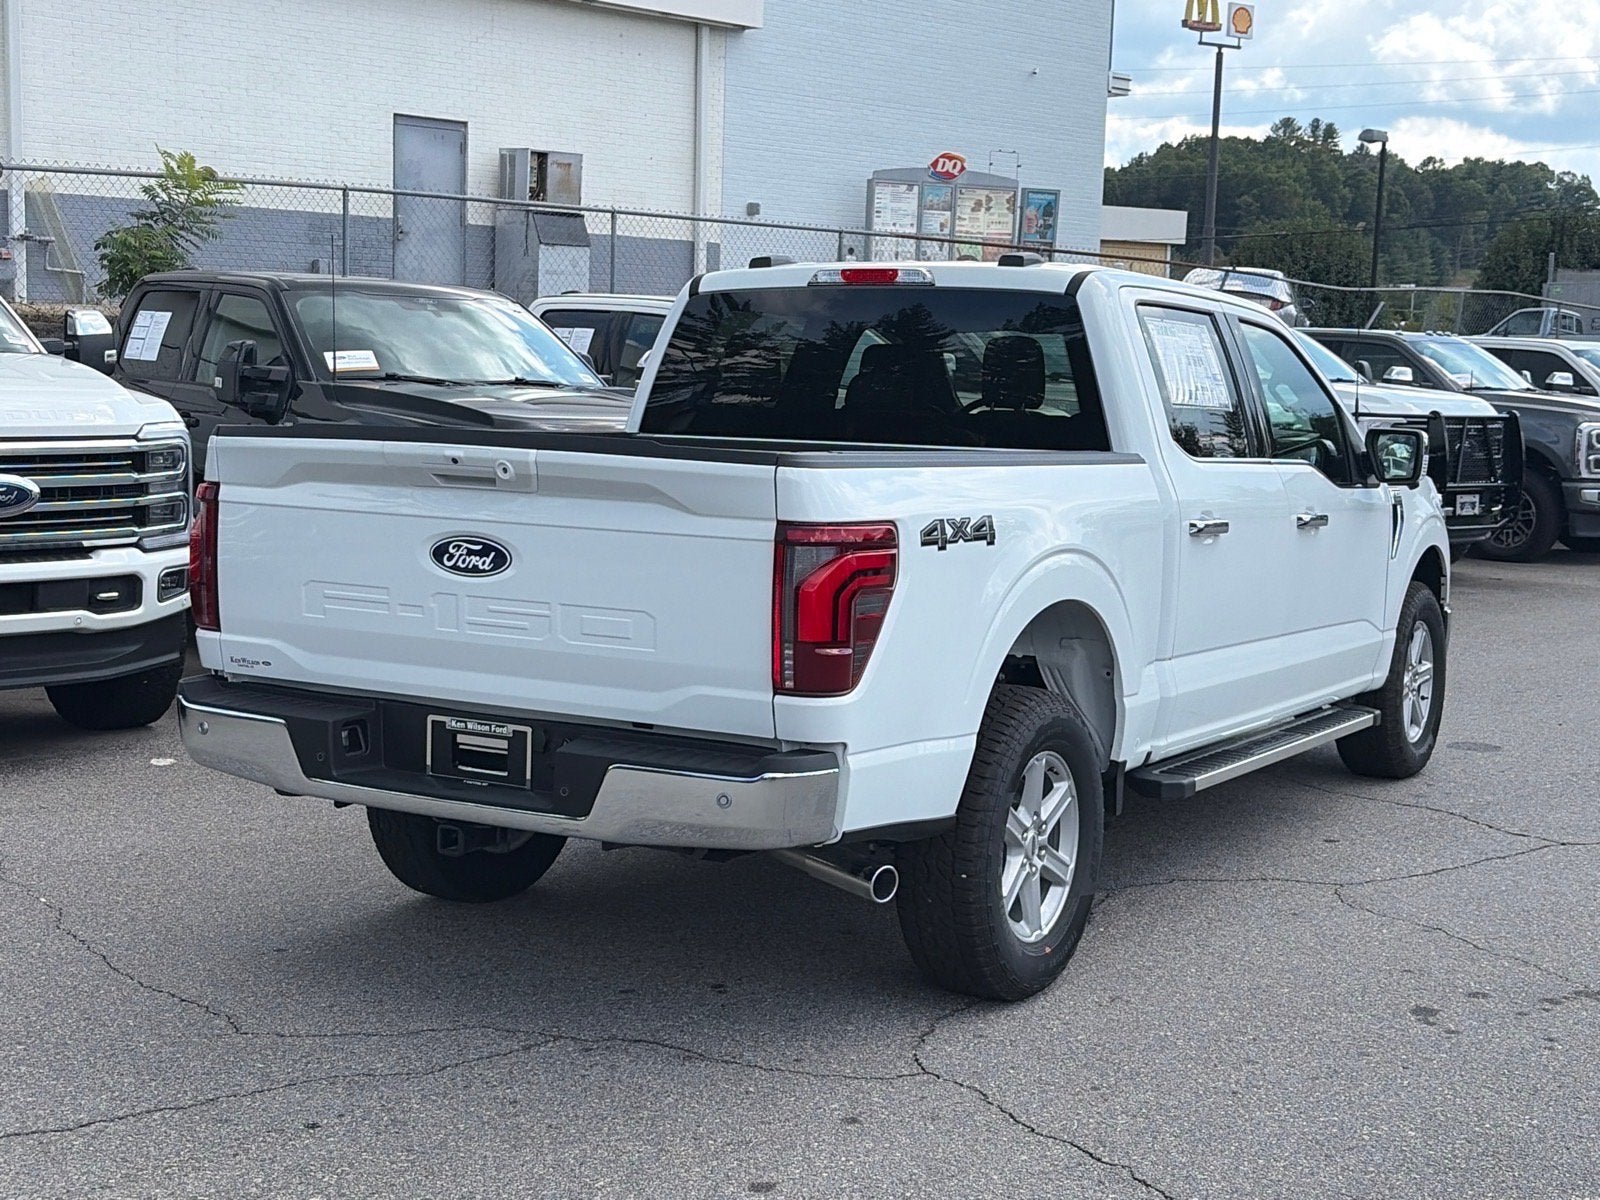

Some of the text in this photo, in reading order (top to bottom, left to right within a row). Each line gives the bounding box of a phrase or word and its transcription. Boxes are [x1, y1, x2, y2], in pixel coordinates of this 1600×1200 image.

[936, 158, 962, 175] DQ
[443, 541, 496, 571] Ford
[302, 579, 656, 652] F-150
[451, 719, 507, 733] Ken Wilson Ford
